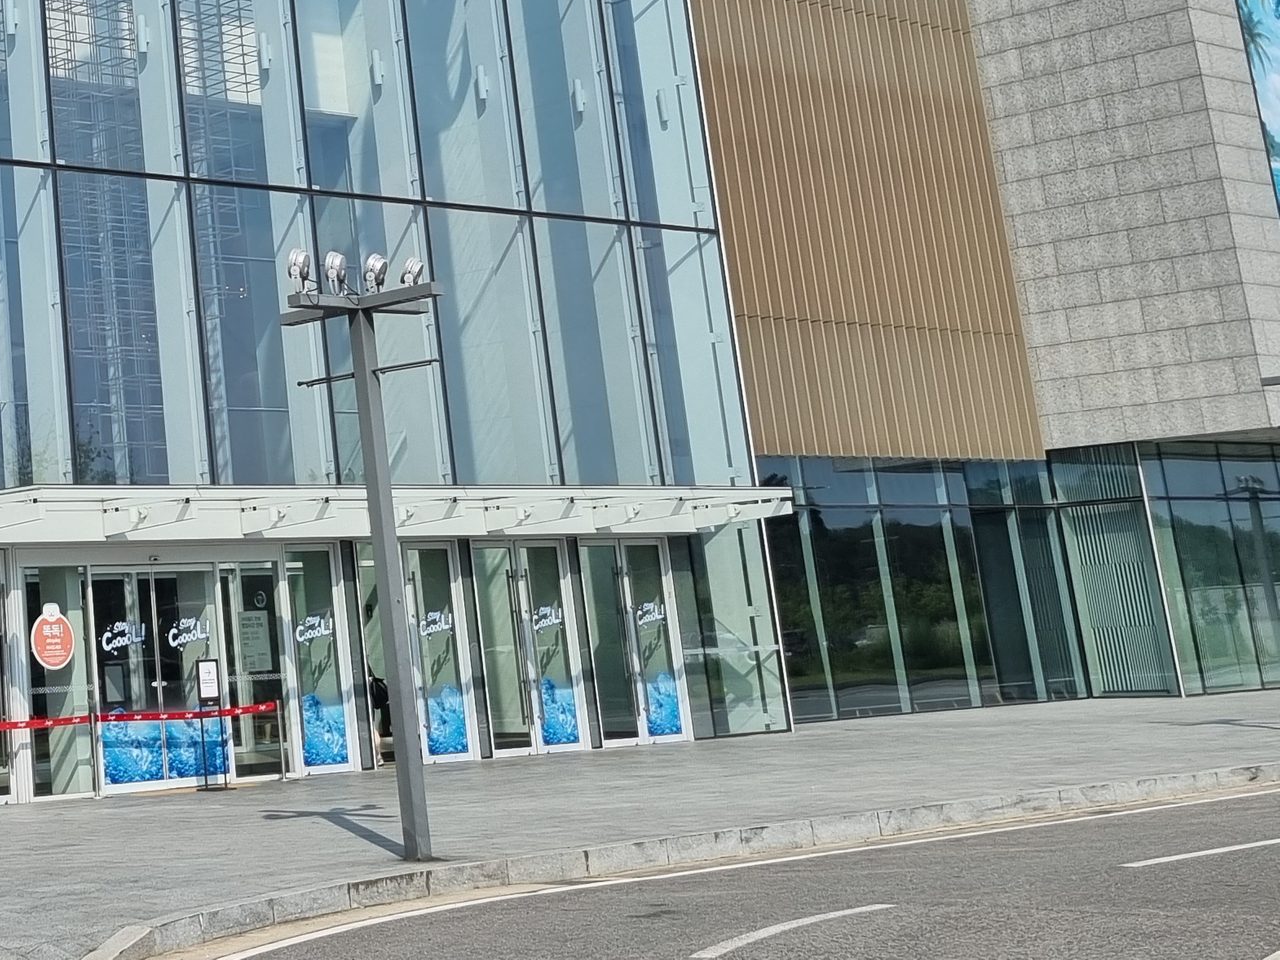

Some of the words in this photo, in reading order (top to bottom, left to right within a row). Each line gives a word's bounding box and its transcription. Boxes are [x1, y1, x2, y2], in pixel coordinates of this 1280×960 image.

[113, 621, 130, 634] Stay
[179, 617, 196, 630] Stay
[305, 615, 321, 627] Stay
